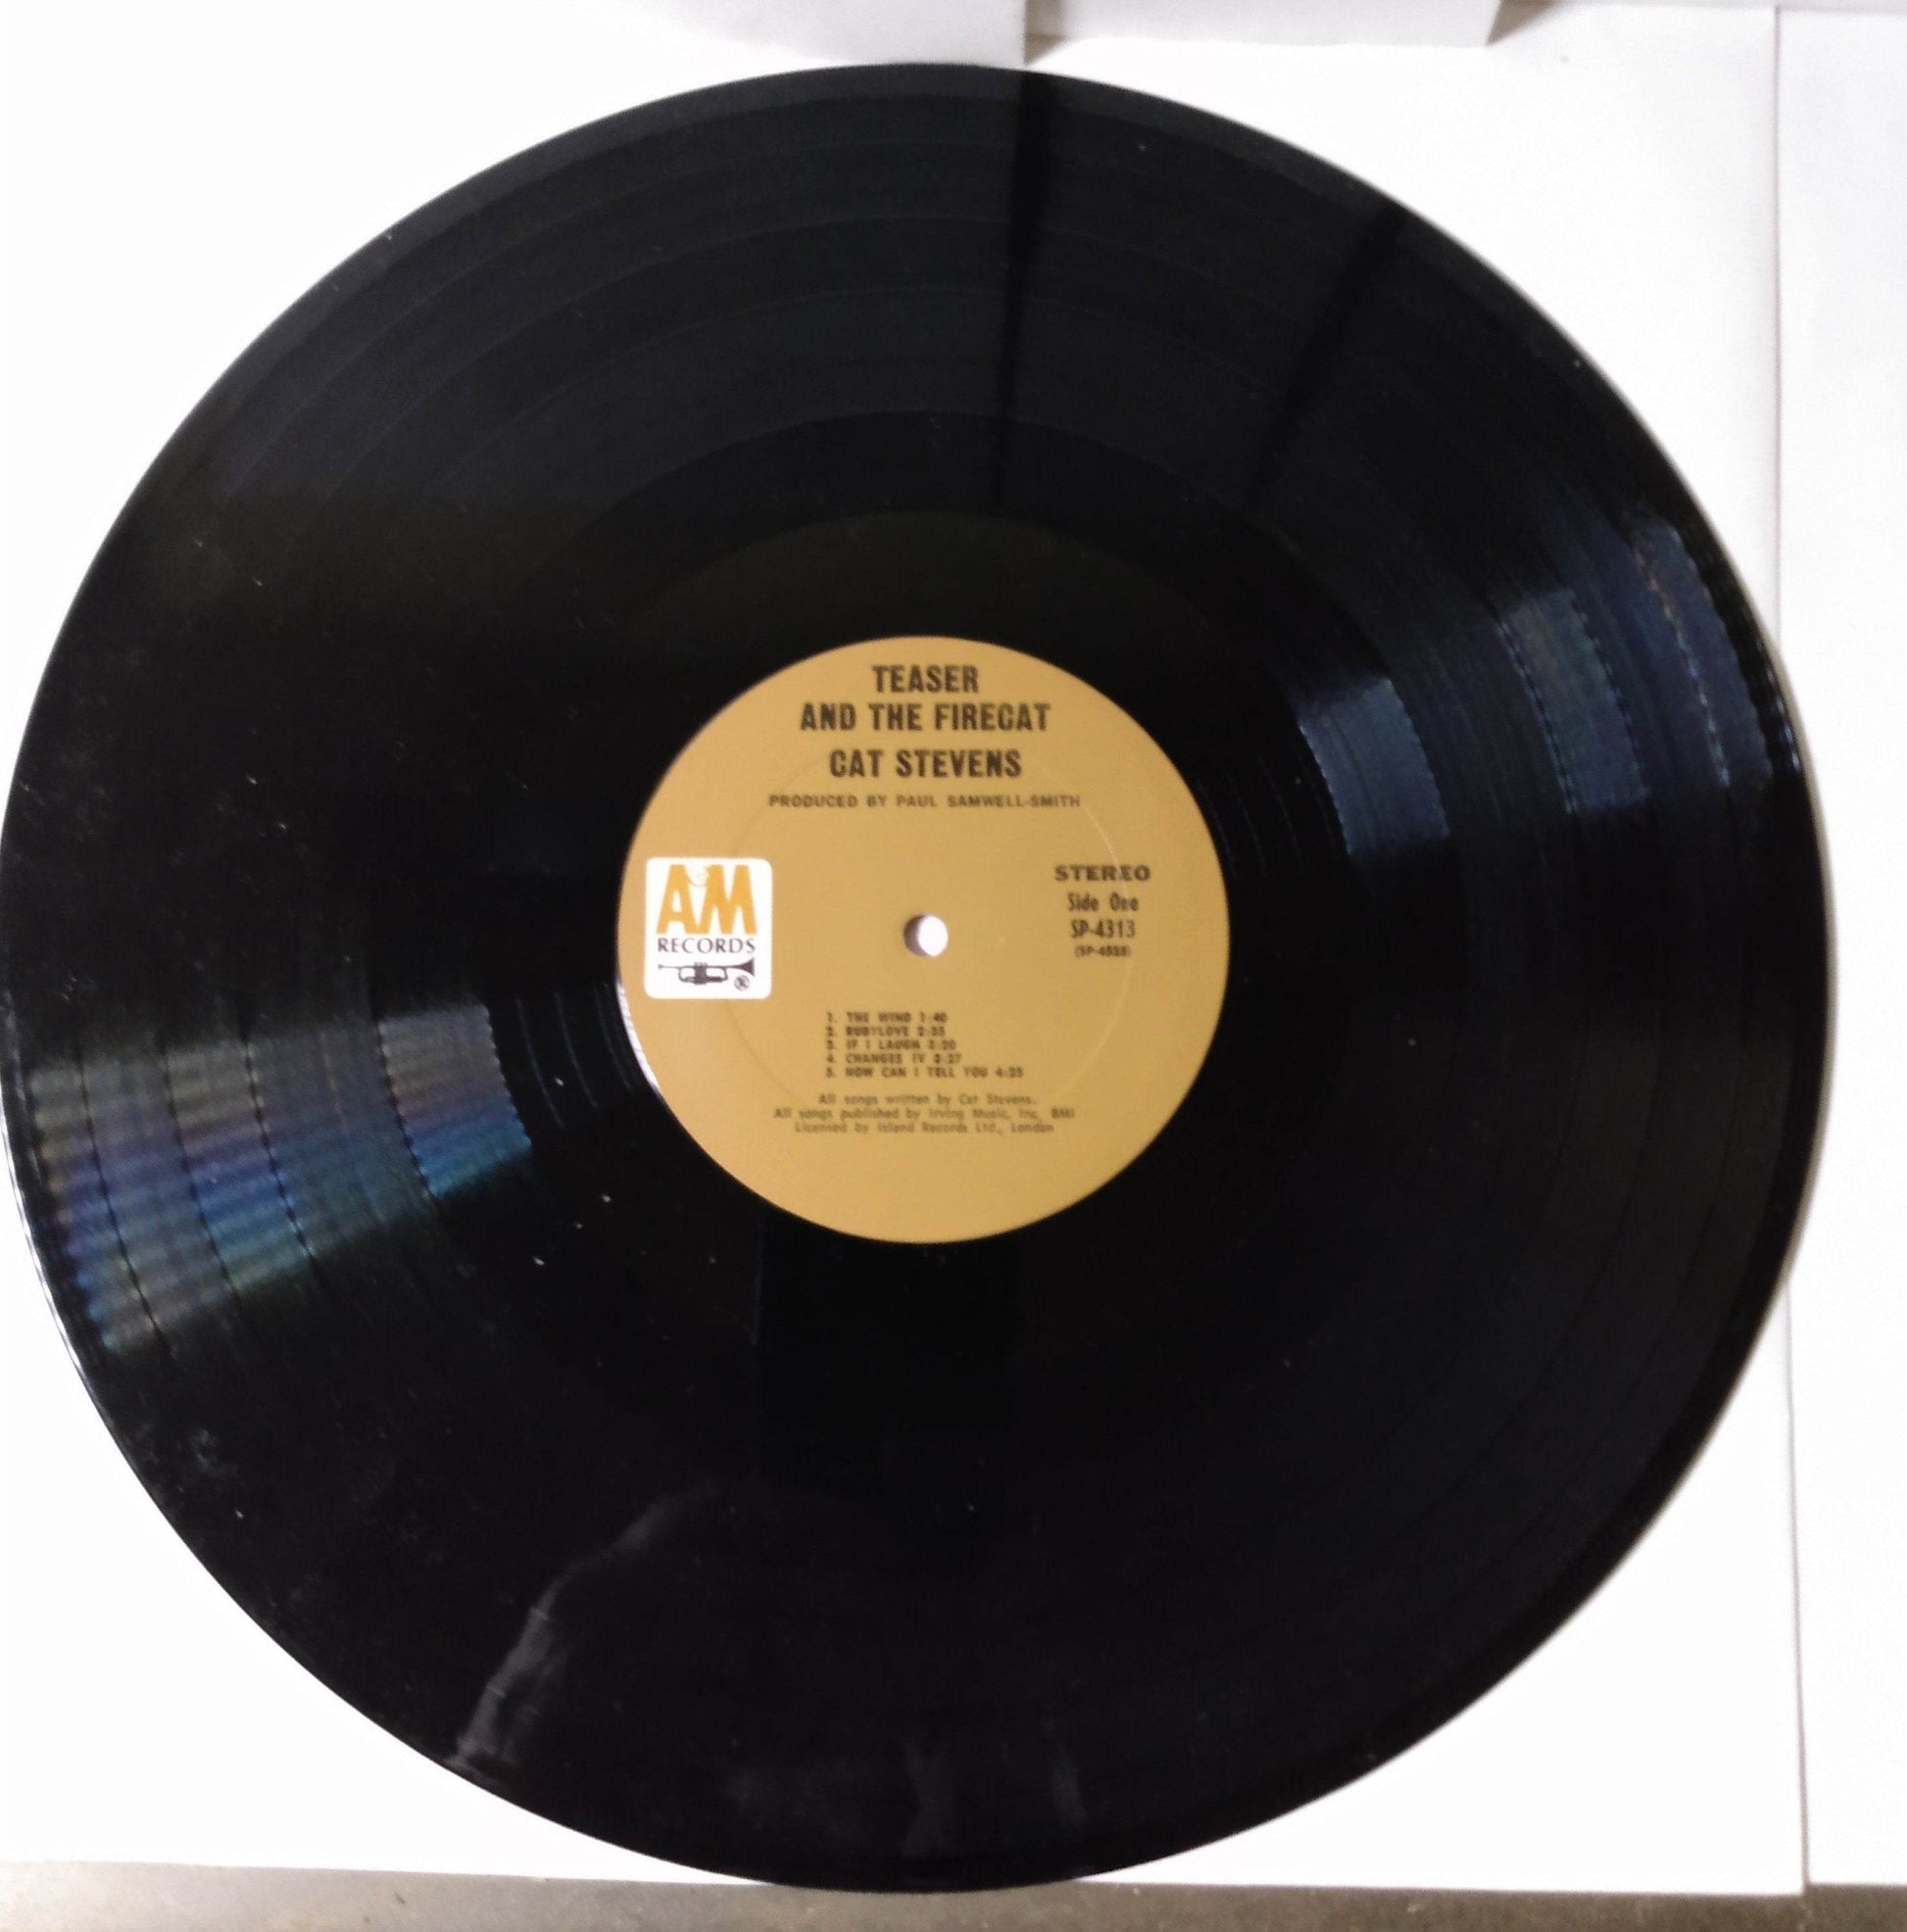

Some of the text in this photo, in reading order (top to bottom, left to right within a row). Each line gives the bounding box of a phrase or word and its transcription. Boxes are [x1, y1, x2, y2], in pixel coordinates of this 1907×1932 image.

[872, 665, 979, 694] TEASER
[801, 703, 1051, 732] AND THE FIRECAT
[830, 749, 1023, 779] CAT STEVENS
[769, 795, 1081, 809] PRODUCED BY PAUL SAMWELL-SMITH
[1055, 865, 1151, 883] STEREO
[1068, 893, 1140, 911] Side One
[1071, 920, 1137, 939] SP-4313
[658, 938, 756, 953] RECORDS
[847, 1012, 870, 1024] THE
[879, 1012, 913, 1024] WIND
[846, 1039, 859, 1050] IF
[846, 1053, 904, 1064] CHANGES
[913, 1053, 926, 1064] IV
[846, 1066, 875, 1078] HOW
[882, 1066, 907, 1078] CAN
[928, 1066, 955, 1078] TELL
[964, 1066, 989, 1078] YOU
[819, 1093, 837, 1104] All
[937, 1092, 952, 1106] by
[774, 1108, 792, 1119] All
[905, 1108, 921, 1120] by
[1051, 1107, 1075, 1119] BMI
